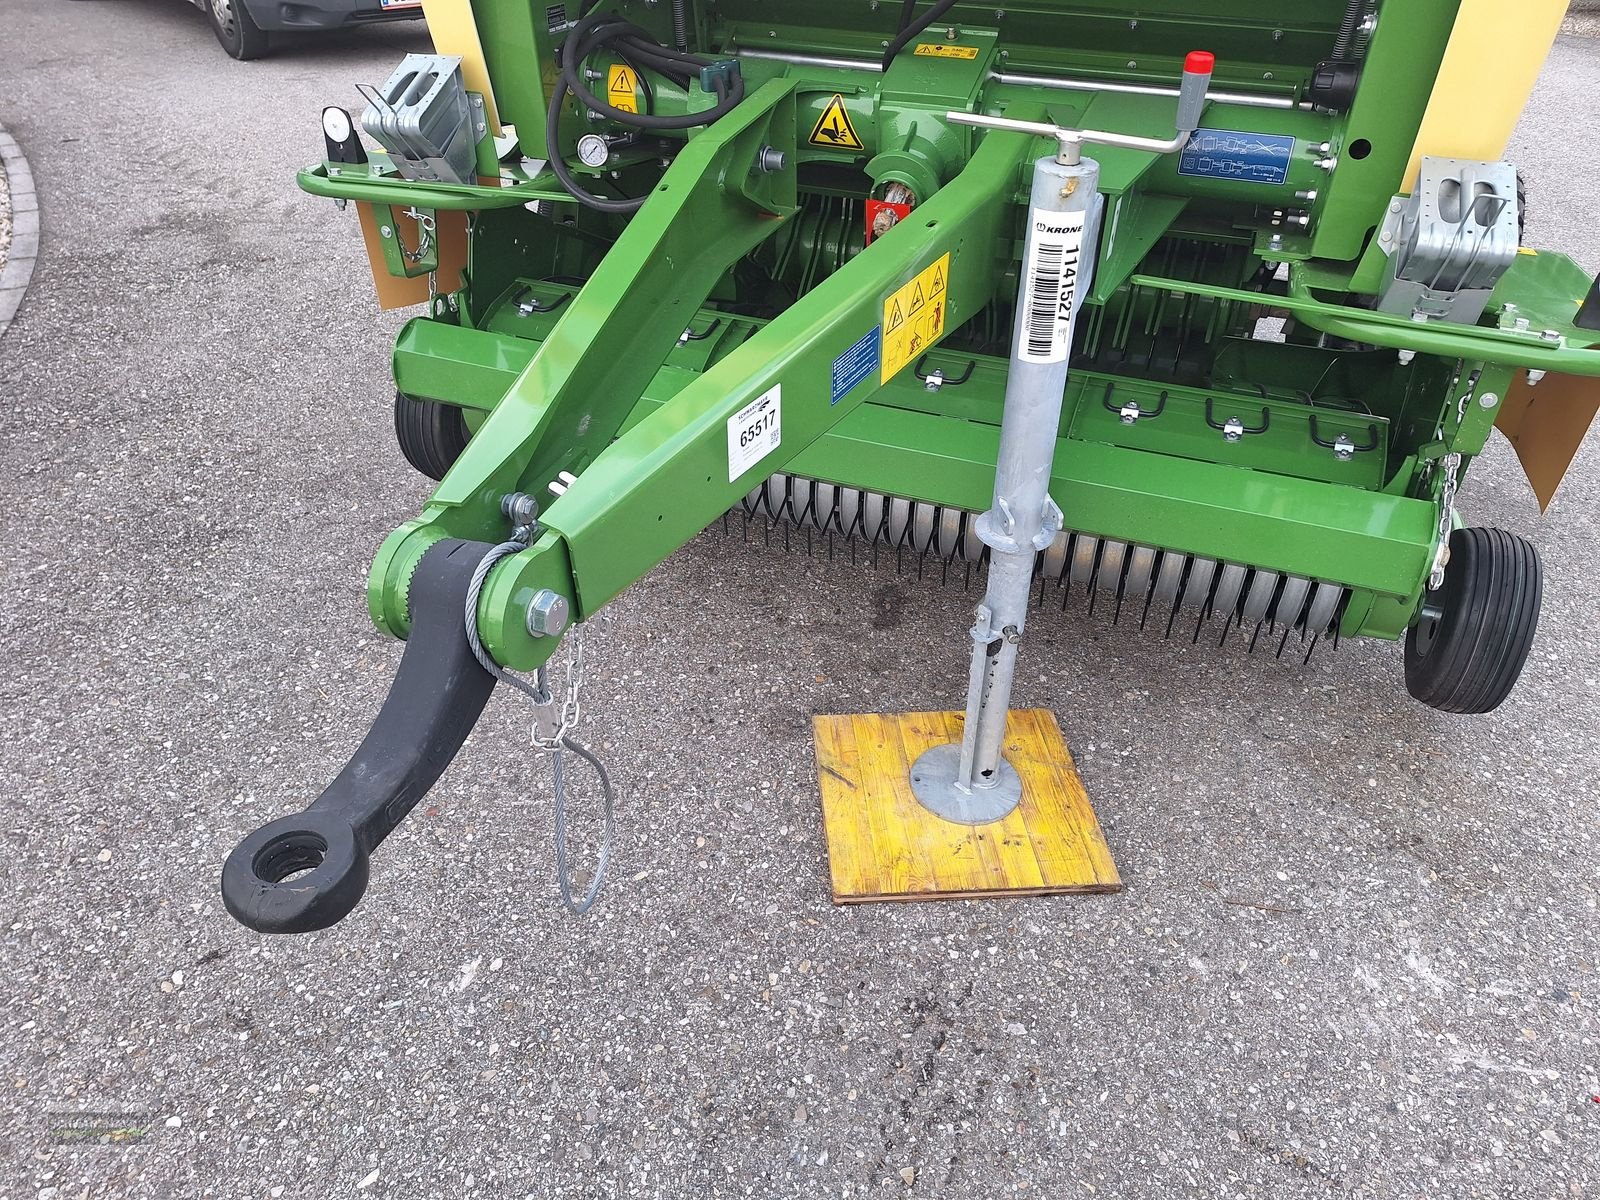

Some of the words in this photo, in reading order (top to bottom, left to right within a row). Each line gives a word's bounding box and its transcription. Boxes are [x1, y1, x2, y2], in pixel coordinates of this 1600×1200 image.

[1046, 225, 1083, 234] KRONE
[1058, 244, 1079, 321] 1141527
[740, 408, 776, 447] 65517
